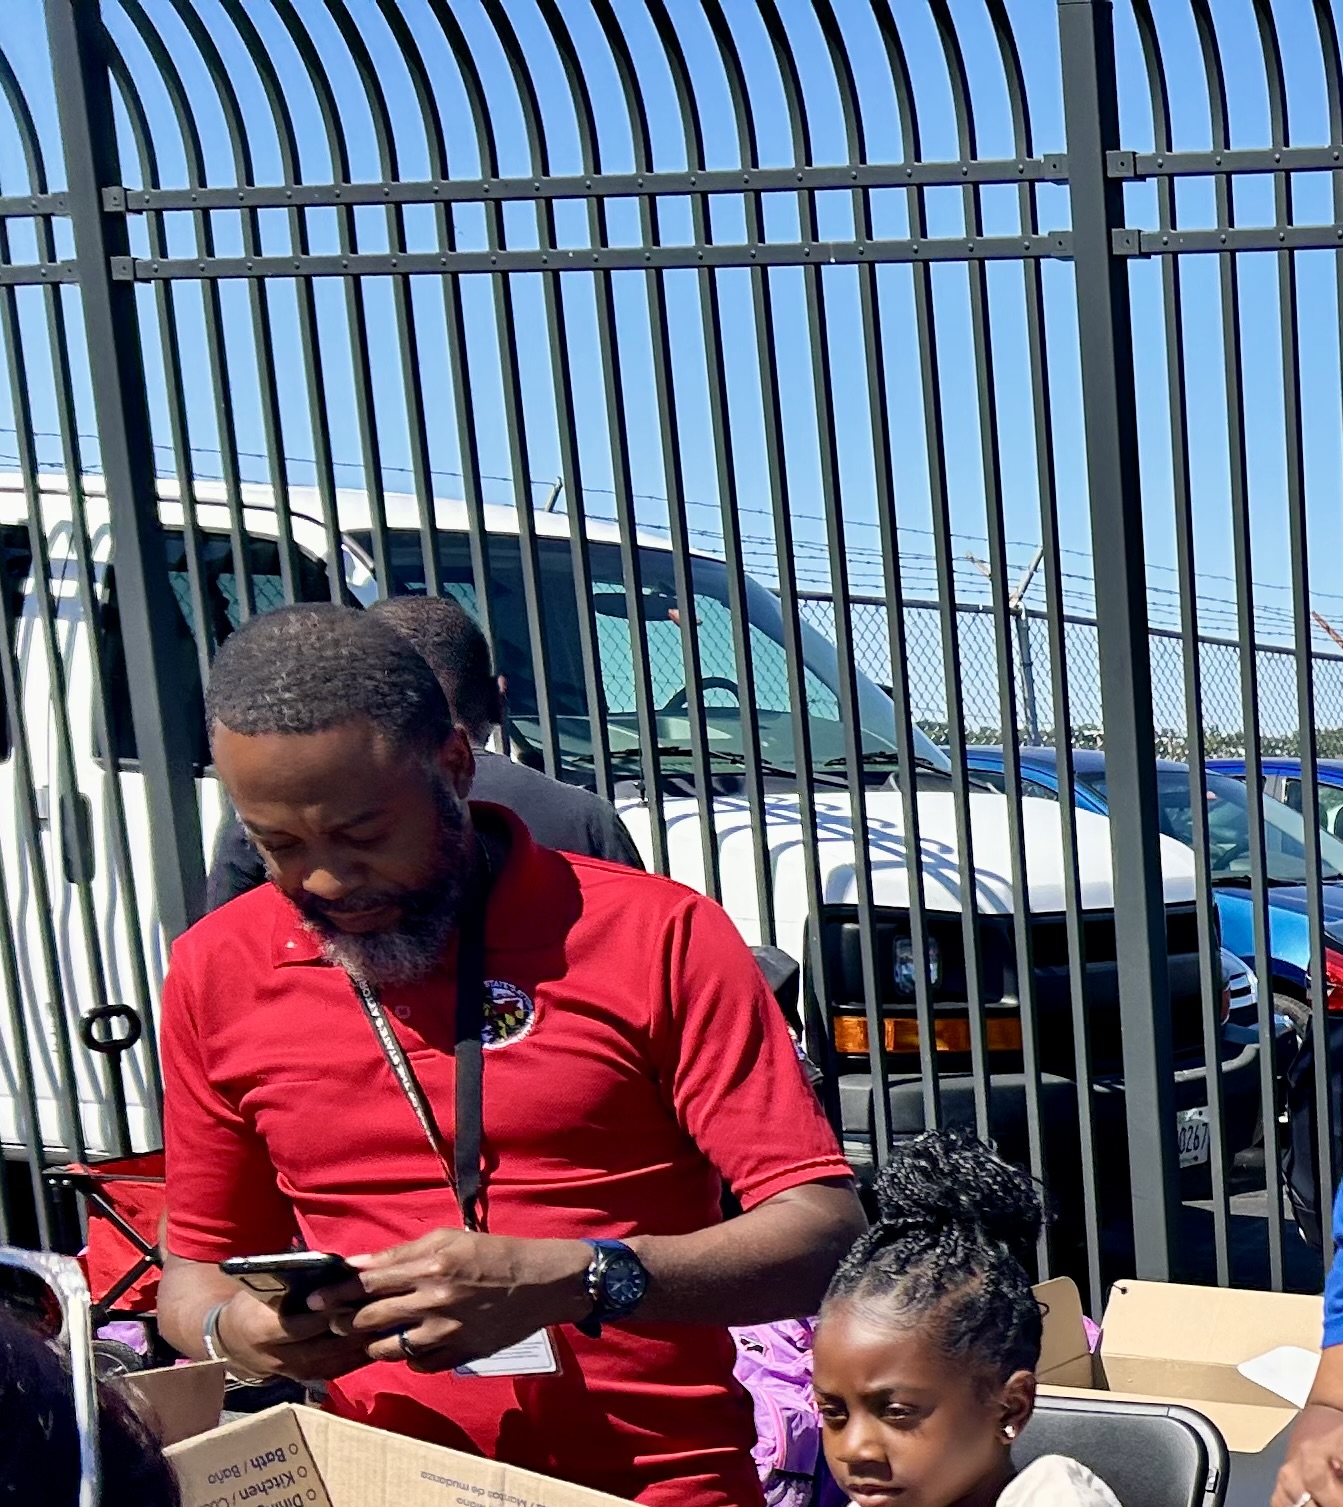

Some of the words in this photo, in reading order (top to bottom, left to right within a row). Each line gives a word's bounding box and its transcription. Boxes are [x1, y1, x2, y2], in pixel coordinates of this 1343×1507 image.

[250, 1447, 287, 1469] Bath
[207, 1464, 241, 1485] Baño
[239, 1471, 296, 1501] Kitchen
[471, 1486, 485, 1497] de
